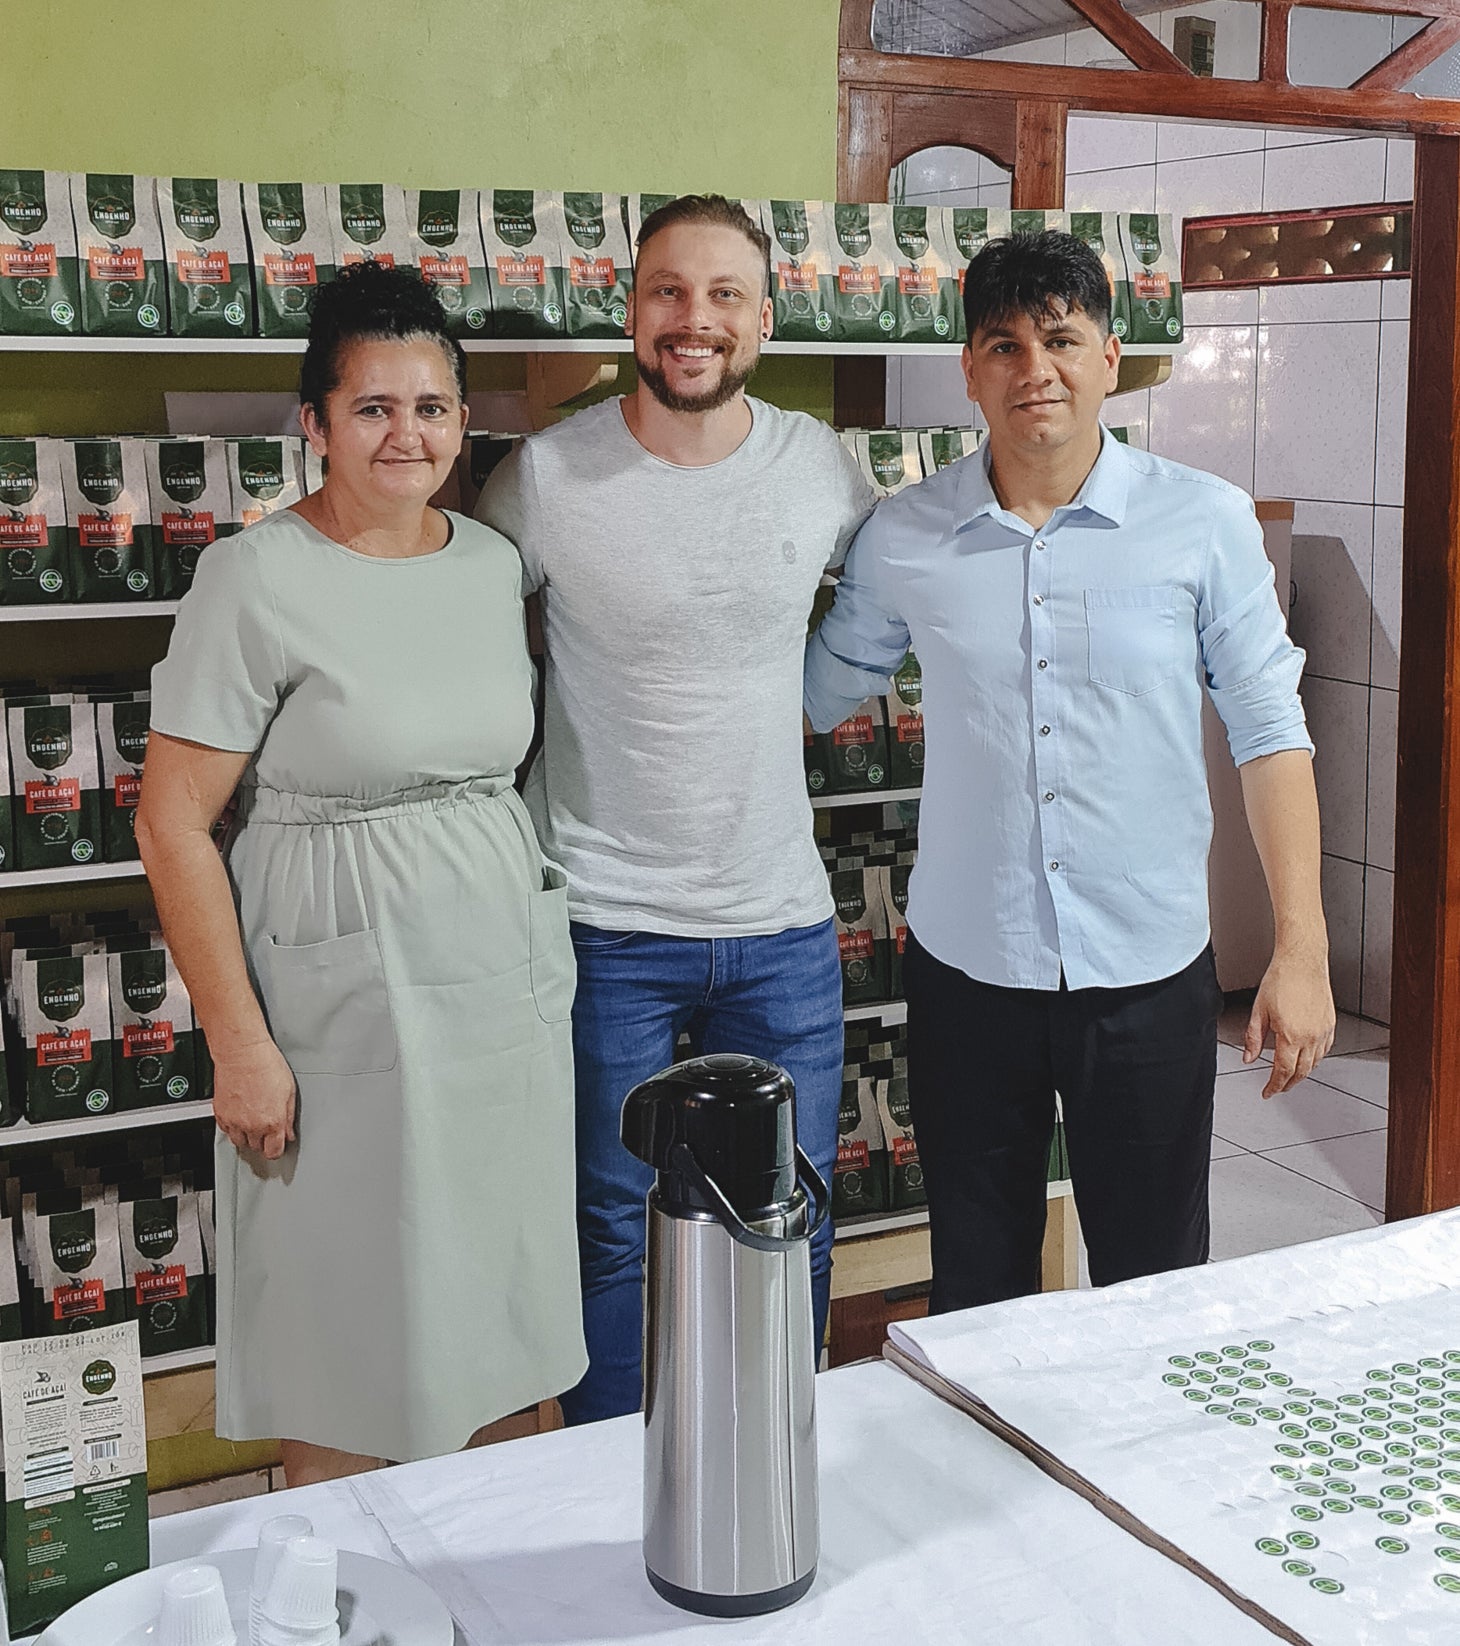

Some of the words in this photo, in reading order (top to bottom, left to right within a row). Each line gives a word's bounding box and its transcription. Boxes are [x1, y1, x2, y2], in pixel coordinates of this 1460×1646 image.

[5, 207, 41, 217] ENGENHO
[94, 211, 130, 221] ENGENHO
[180, 214, 214, 225] ENGENHO
[267, 217, 301, 227] ENGENHO
[347, 219, 381, 228] ENGENHO
[422, 223, 453, 233] ENGENHO
[500, 222, 531, 232] ENGENHO
[571, 224, 600, 233] ENGENHO
[111, 258, 120, 266] DE
[198, 259, 208, 268] DE
[285, 262, 295, 271] DE
[441, 264, 450, 272] DE
[516, 263, 525, 272] DE
[0, 478, 33, 487] NGENHO
[83, 478, 118, 487] ENGENHO
[167, 476, 201, 487] ENGENHO
[245, 476, 279, 484] ENGENHO
[0, 523, 13, 532] AFÉ
[15, 524, 24, 532] DE
[31, 742, 67, 752] ENGENHO
[47, 790, 57, 798] DE
[128, 983, 161, 997] ENGENHO
[44, 993, 79, 1004] ENGENHO
[143, 1032, 151, 1041] DE
[139, 1229, 173, 1243] ENGENHO
[57, 1243, 91, 1258] ENGENHO
[155, 1278, 165, 1286] DE
[73, 1292, 82, 1301] DE
[85, 1371, 112, 1383] ENGENHO
[40, 1386, 49, 1396] DE
